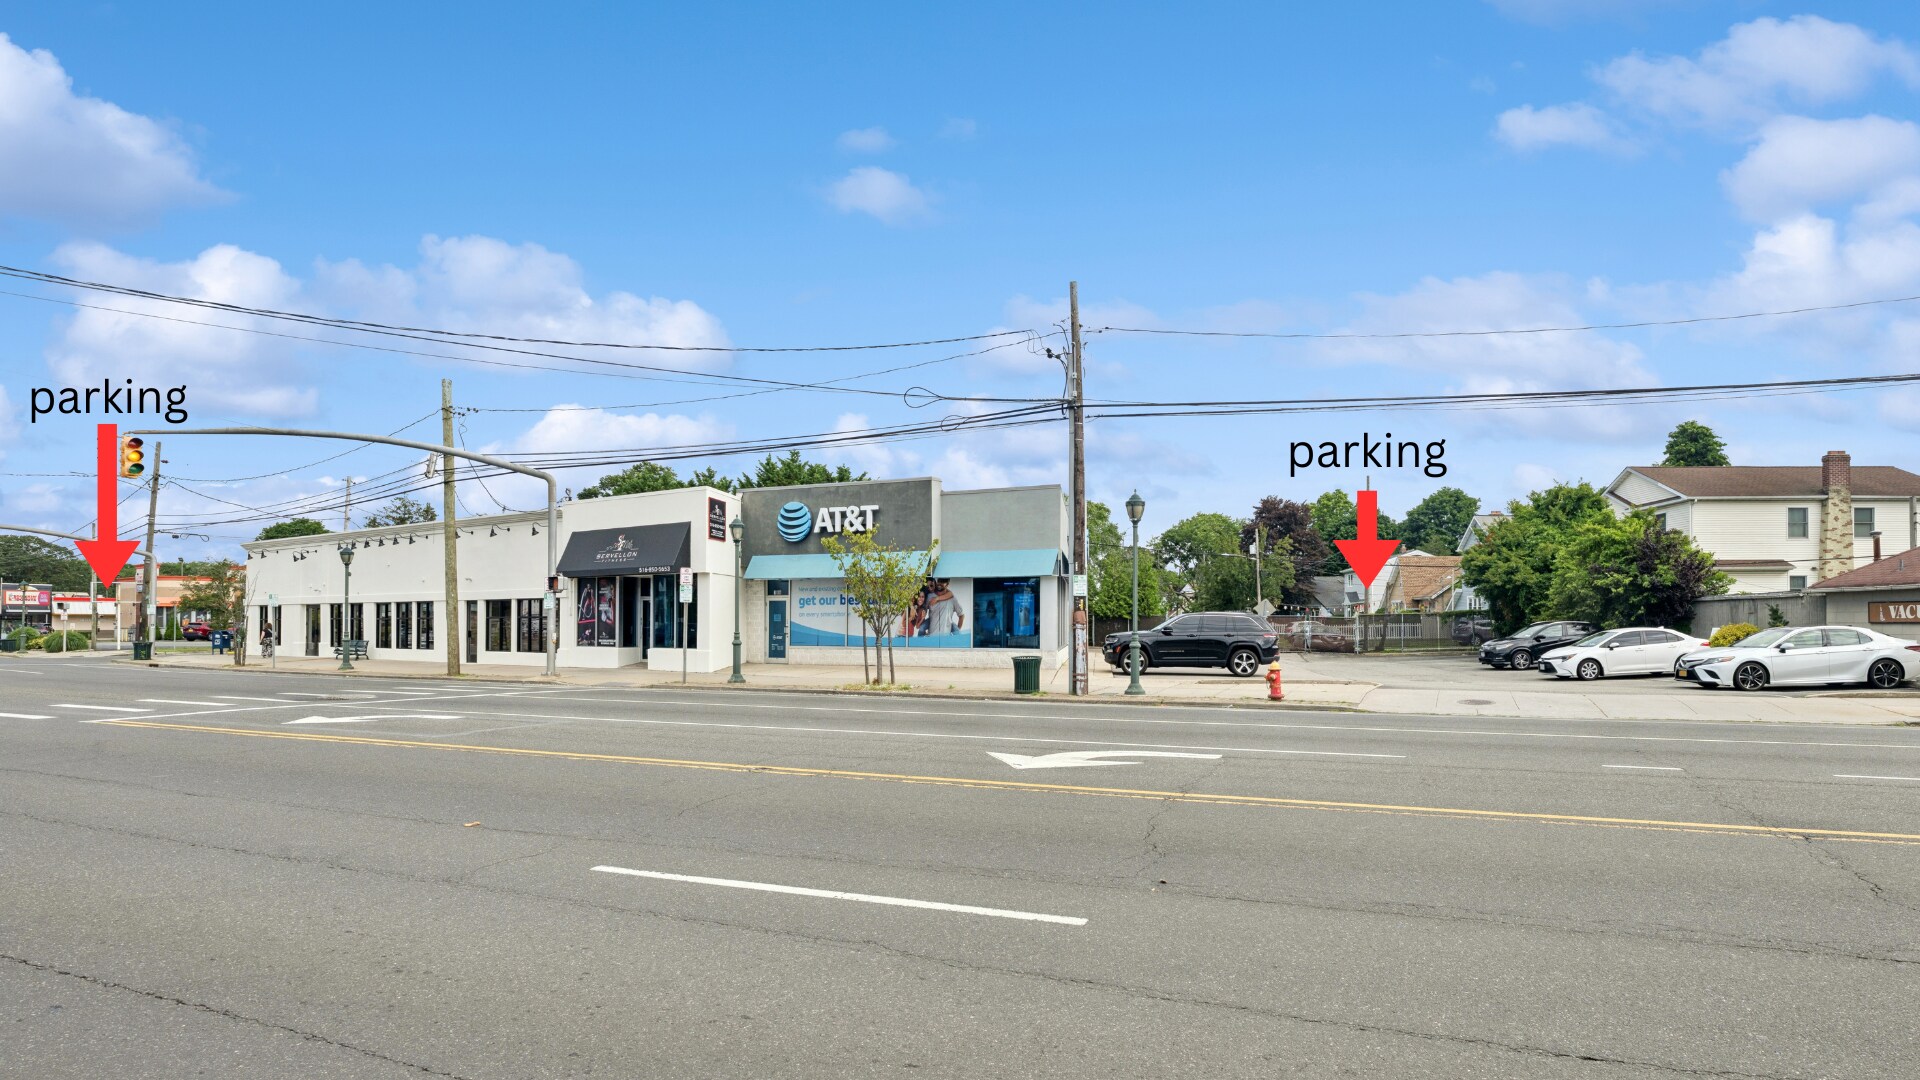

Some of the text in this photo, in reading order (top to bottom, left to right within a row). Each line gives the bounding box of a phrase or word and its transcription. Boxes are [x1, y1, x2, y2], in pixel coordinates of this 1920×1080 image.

[813, 504, 879, 533] AT&T
[595, 551, 638, 560] SERVELLON
[798, 595, 816, 608] get
[818, 596, 837, 606] our
[839, 593, 863, 606] bes
